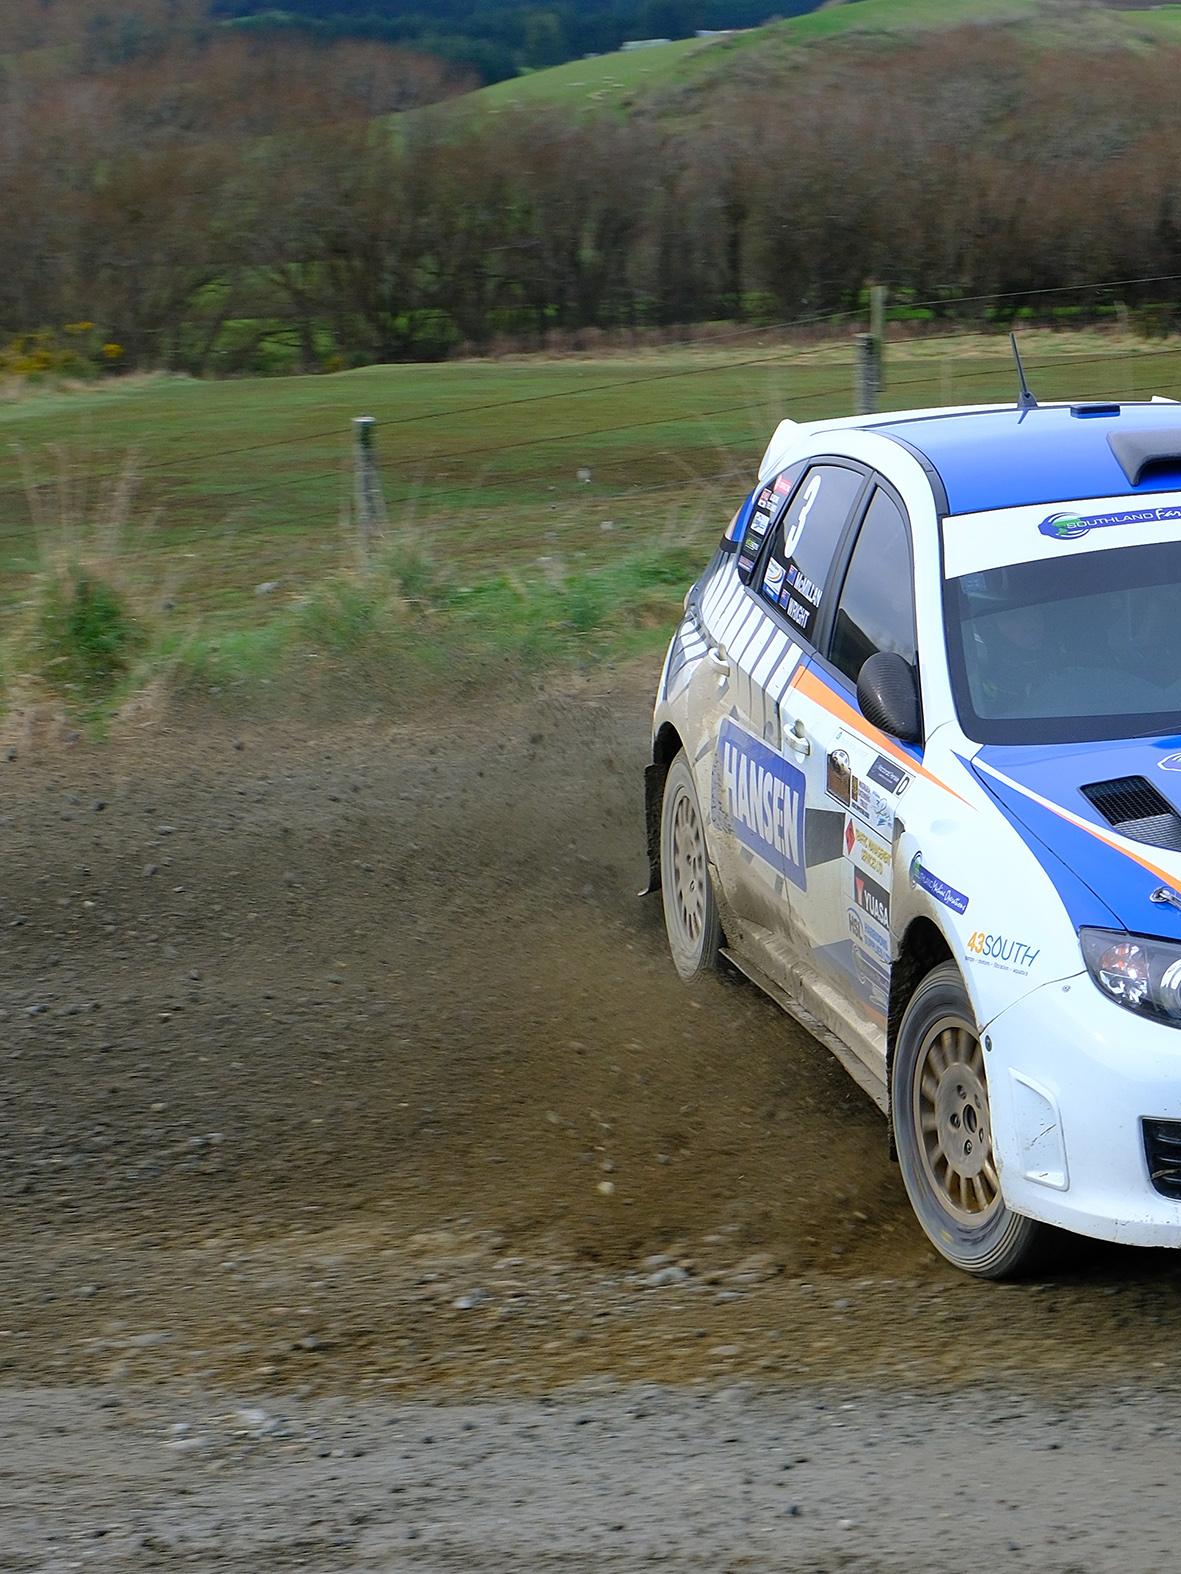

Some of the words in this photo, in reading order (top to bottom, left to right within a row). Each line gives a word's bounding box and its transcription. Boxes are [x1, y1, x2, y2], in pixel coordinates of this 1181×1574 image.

[784, 474, 822, 559] 3
[1066, 511, 1153, 530] SOUTHLAND
[723, 741, 800, 867] HANSEN
[864, 890, 889, 928] YUASA
